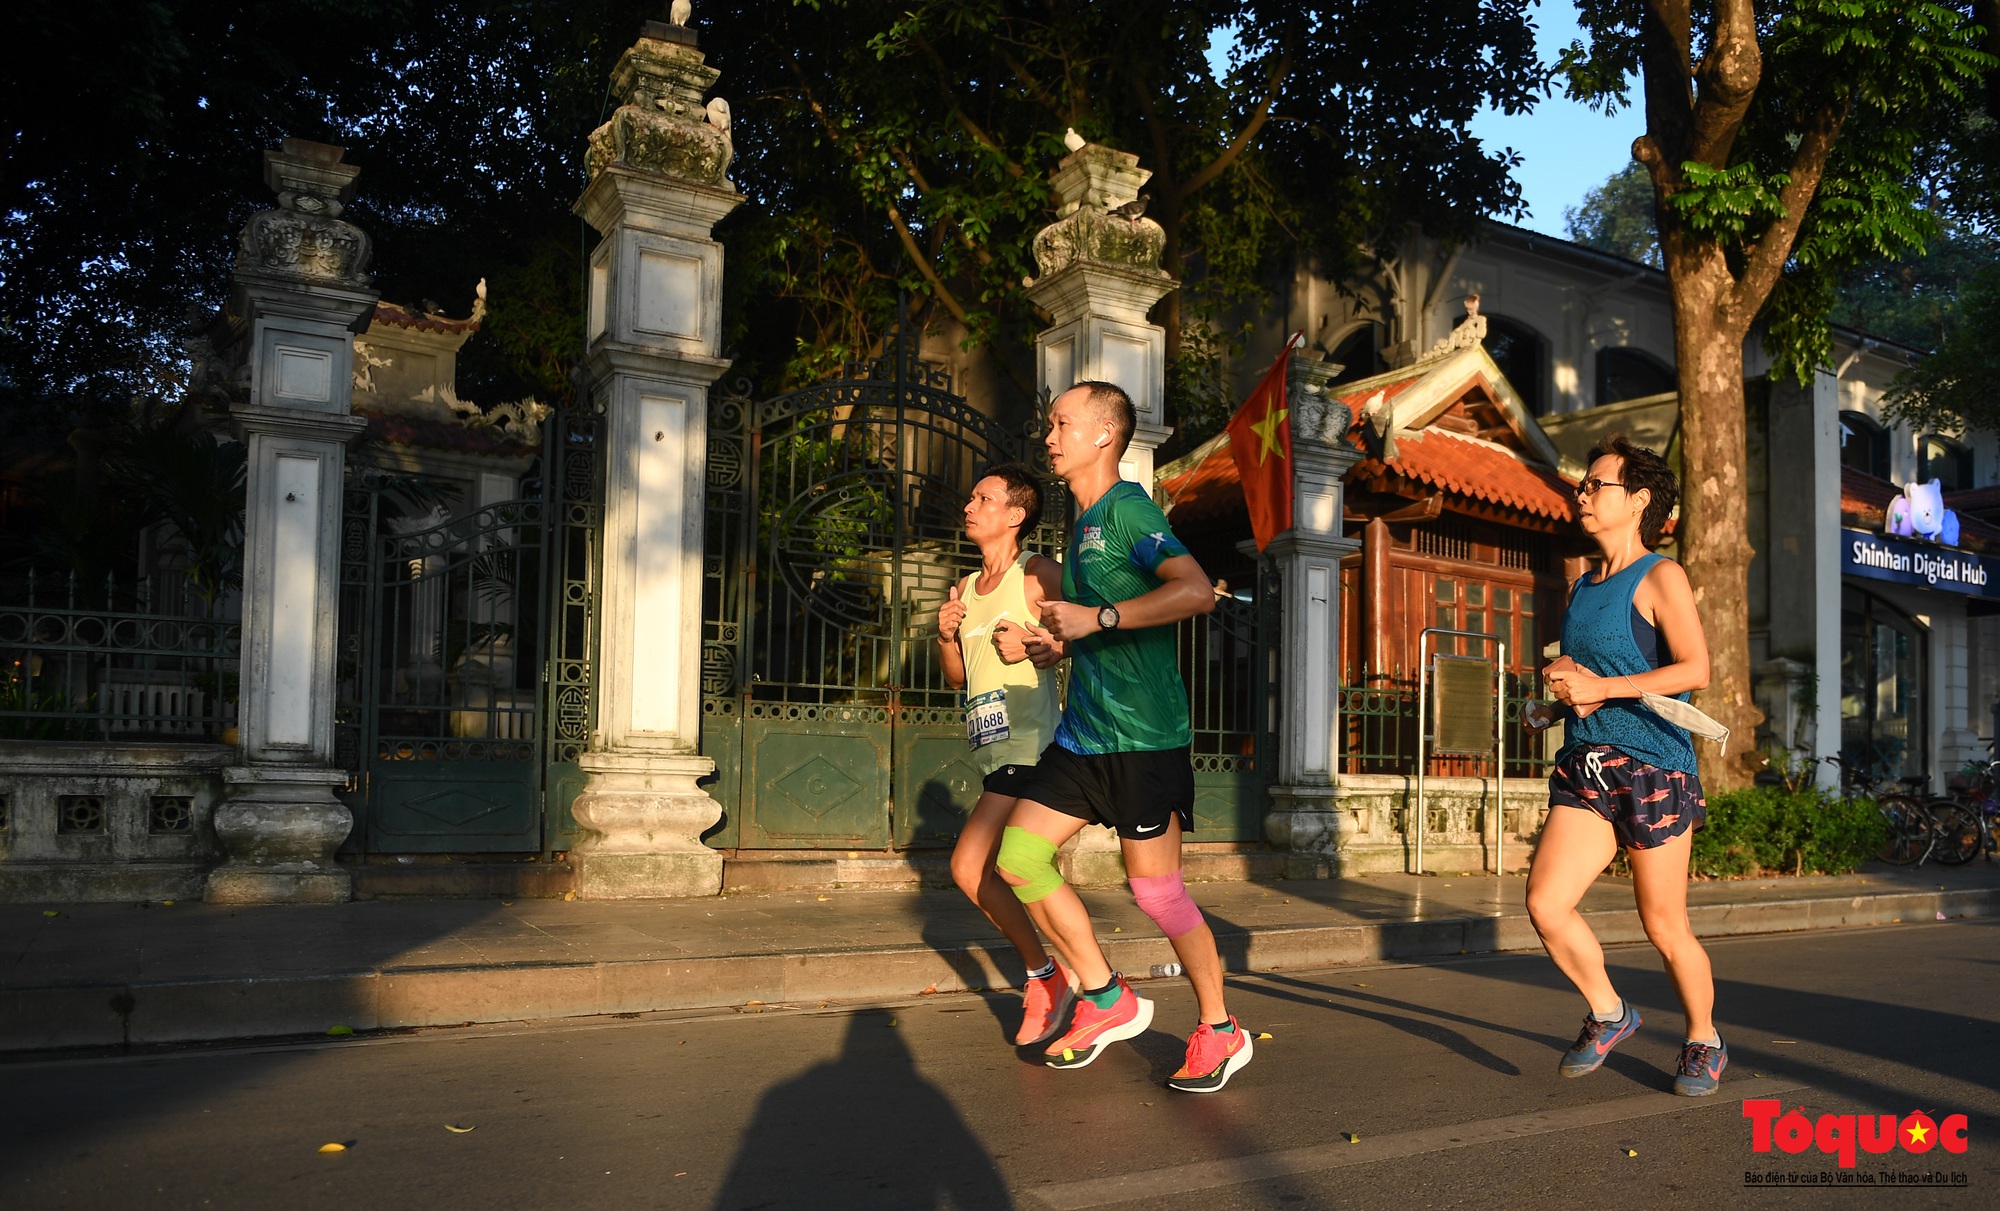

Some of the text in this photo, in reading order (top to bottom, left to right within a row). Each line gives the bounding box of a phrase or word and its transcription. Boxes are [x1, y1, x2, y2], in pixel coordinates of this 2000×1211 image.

[1852, 540, 1988, 586] Shinhan Digital Hub
